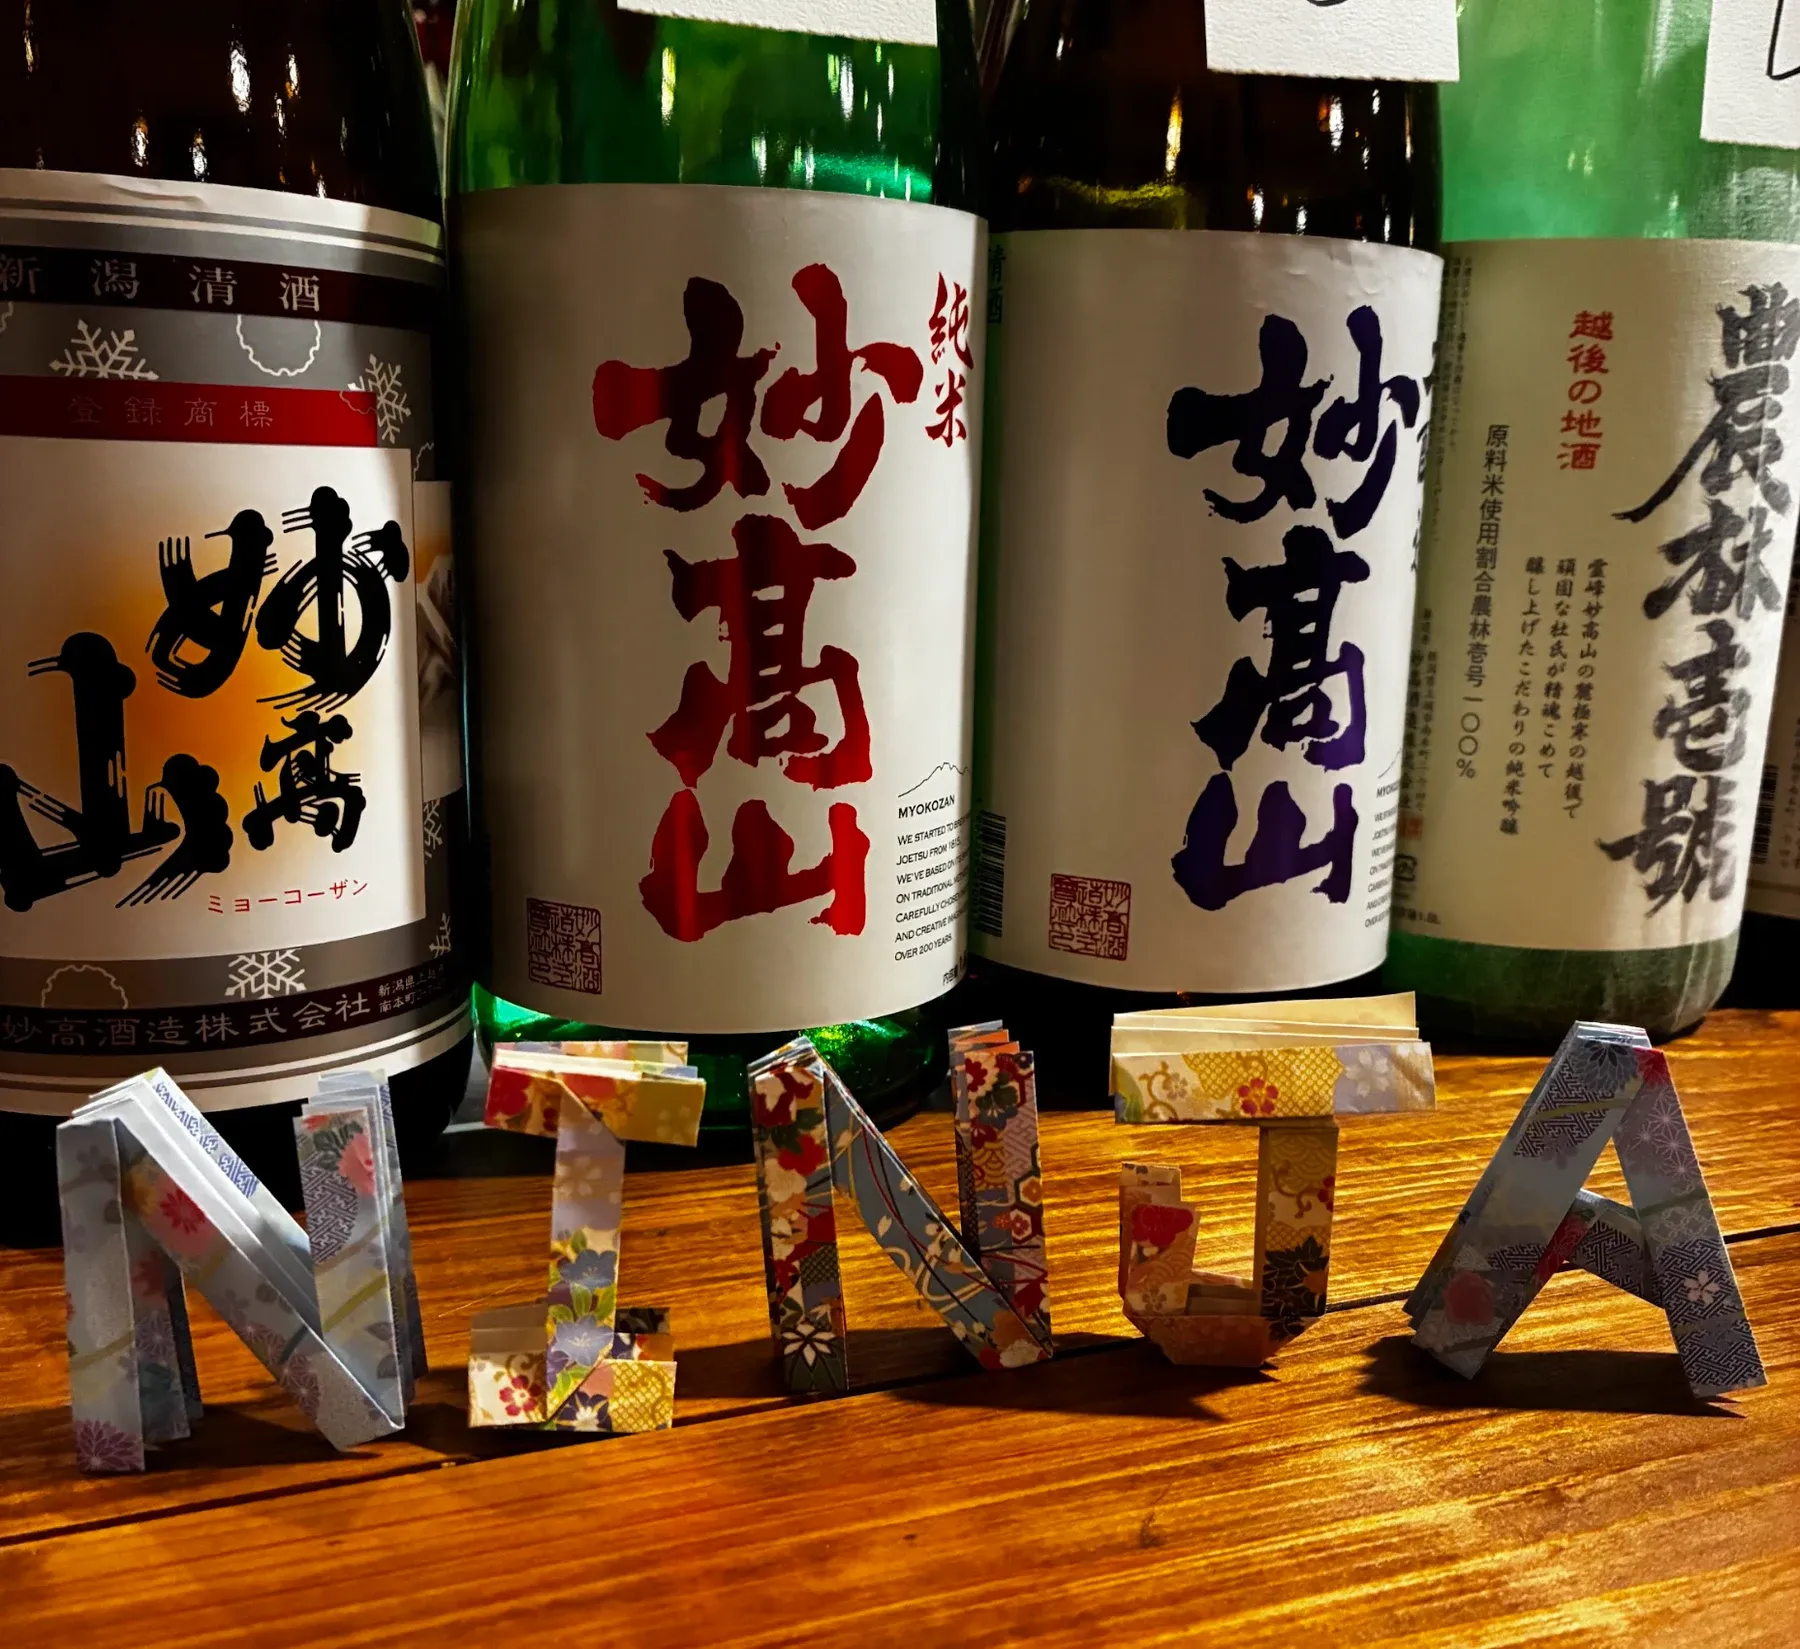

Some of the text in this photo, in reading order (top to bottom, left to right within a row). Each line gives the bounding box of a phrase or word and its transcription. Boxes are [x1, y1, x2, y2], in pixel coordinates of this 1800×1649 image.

[925, 272, 974, 448] 純米
[1556, 310, 1614, 470] 越後の地酒
[68, 394, 275, 428] 登録商標
[898, 795, 956, 819] MYOKOZAN
[897, 834, 913, 846] WE
[914, 825, 946, 842] STARTED
[896, 850, 928, 866] JOETSU
[929, 844, 948, 858] FROM
[896, 870, 924, 885] WE'VE
[925, 862, 947, 878] BASED
[208, 879, 368, 914] ミョーコーザン
[896, 893, 911, 904] ON
[911, 879, 954, 900] TRADITIONAL
[895, 903, 940, 923] CAREFULLY
[894, 917, 947, 943] AND CREATIVE
[895, 946, 920, 961] OVER
[919, 941, 934, 955] 200
[2, 992, 371, 1046] 妙高酒造株式会社
